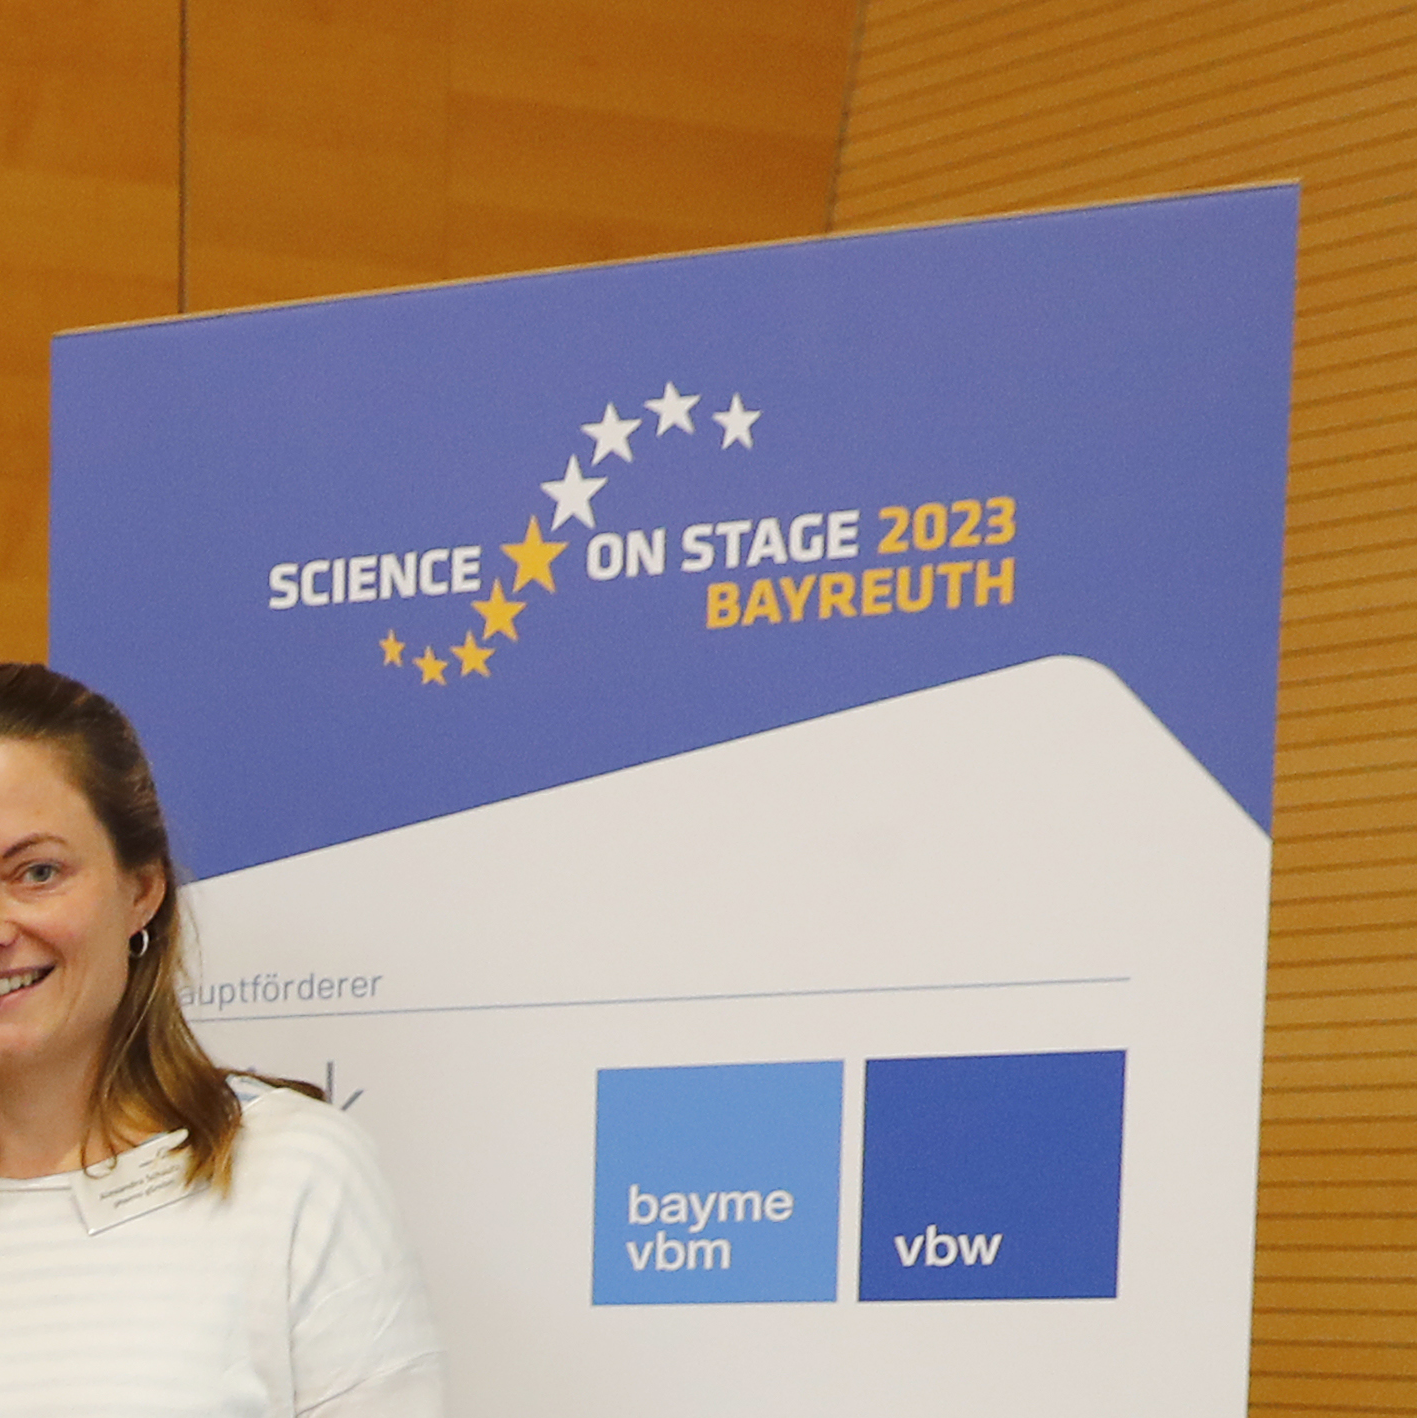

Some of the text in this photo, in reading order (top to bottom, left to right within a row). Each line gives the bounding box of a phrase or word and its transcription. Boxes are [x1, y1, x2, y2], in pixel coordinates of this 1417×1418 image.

[269, 497, 1017, 609] SCIENCE ON STAGE 2023
[705, 557, 1015, 628] BAYREUTH
[180, 972, 383, 1011] auptförderer
[628, 1183, 795, 1233] bayme
[626, 1228, 732, 1271] vbm
[894, 1224, 1003, 1267] vbw
